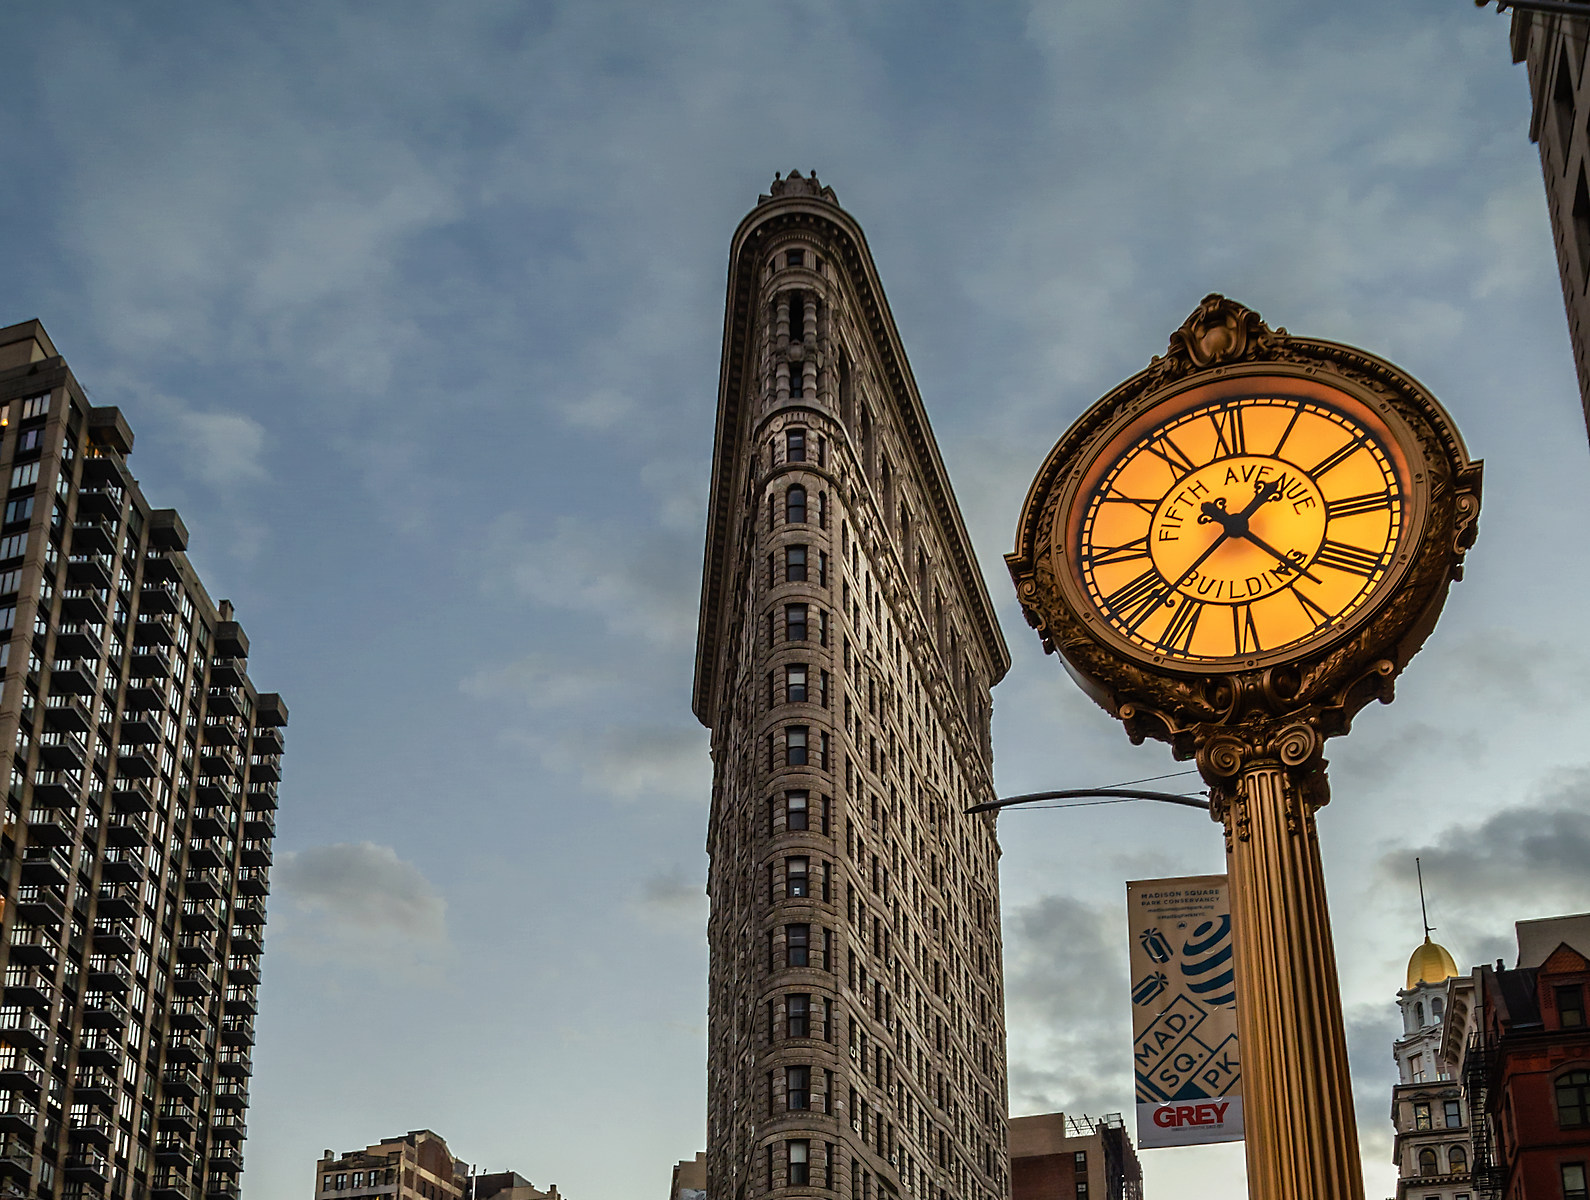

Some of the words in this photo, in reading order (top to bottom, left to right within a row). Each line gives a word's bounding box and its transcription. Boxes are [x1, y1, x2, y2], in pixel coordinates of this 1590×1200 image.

[1159, 480, 1210, 542] FIFTH
[1224, 464, 1316, 516] AVENUE
[1141, 890, 1181, 899] MADISON
[1185, 889, 1220, 897] SQUARE
[1164, 897, 1220, 905] CONSERVANCY
[1135, 1013, 1194, 1067] MAD.
[1160, 1053, 1203, 1088] SQ.
[1202, 1052, 1240, 1089] PK
[1153, 1102, 1230, 1128] GREY
